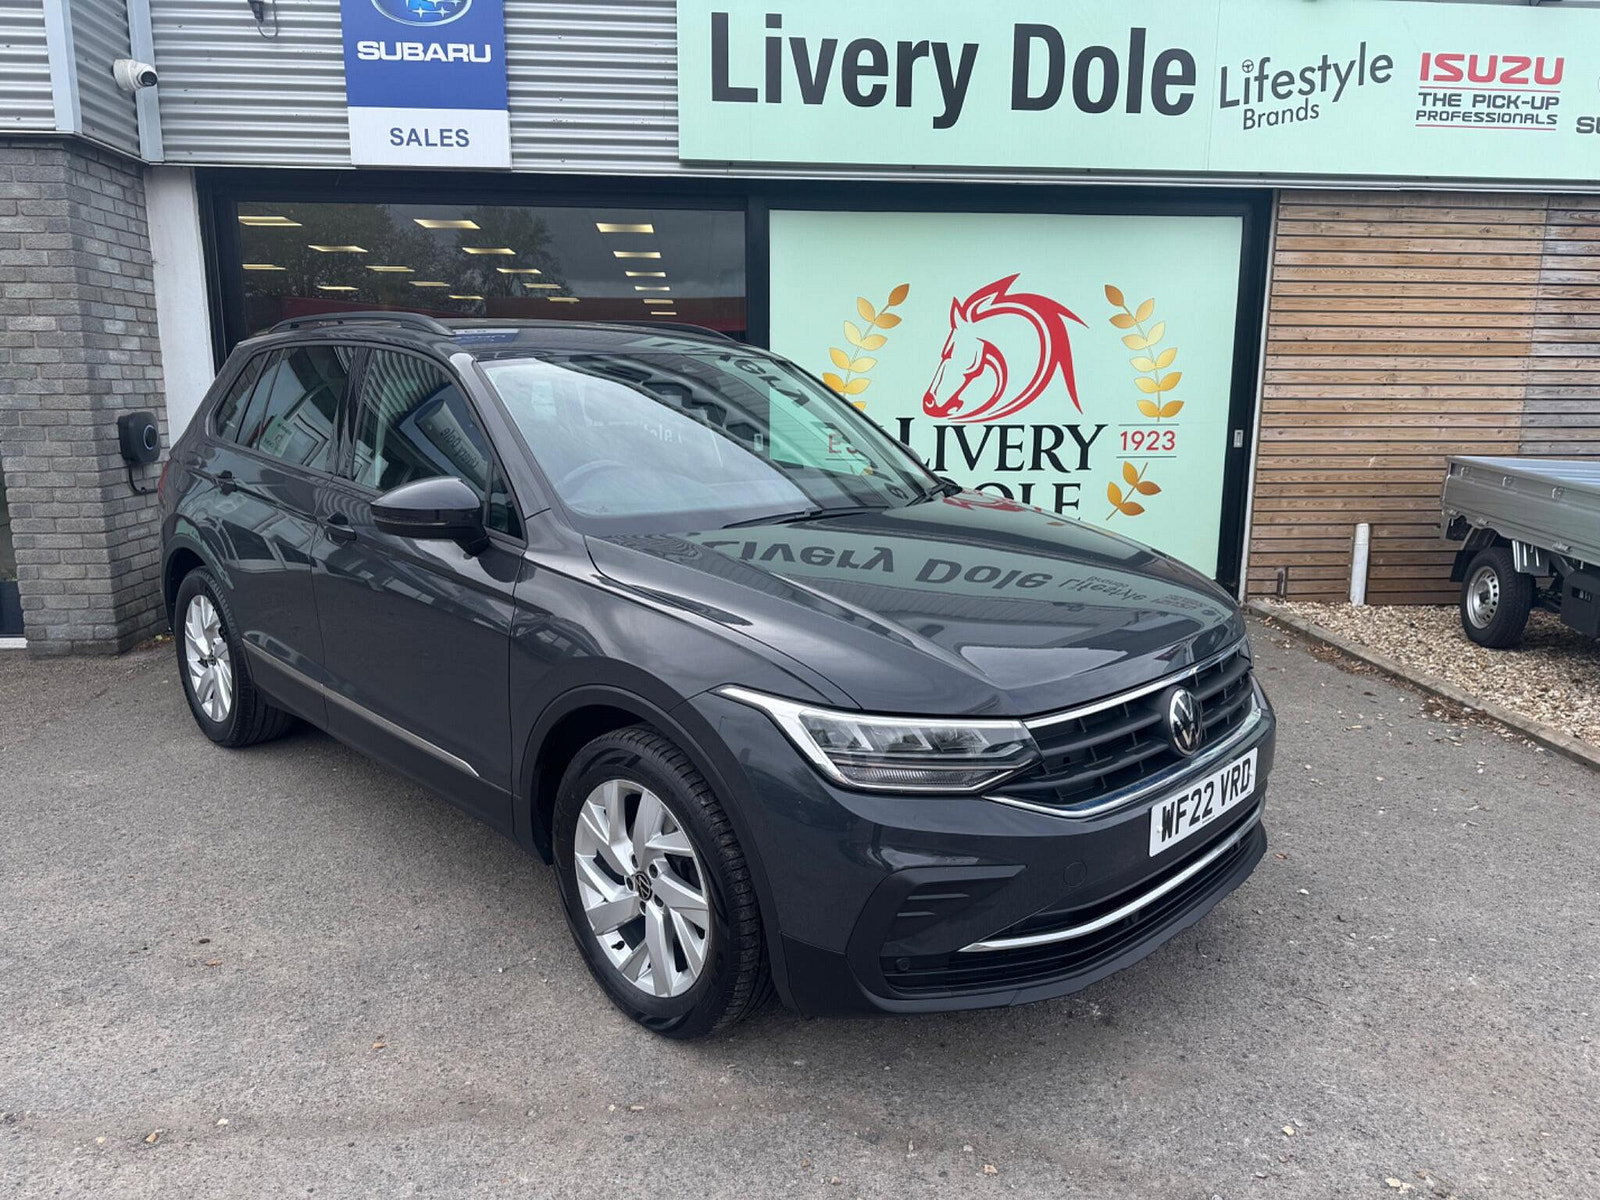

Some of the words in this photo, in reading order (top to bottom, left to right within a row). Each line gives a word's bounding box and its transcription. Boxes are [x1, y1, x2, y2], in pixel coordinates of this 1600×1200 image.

[357, 40, 492, 63] SUBARU
[711, 12, 979, 129] Livery
[1011, 23, 1196, 116] Dole
[1220, 41, 1394, 109] Lifestyle
[1419, 52, 1565, 86] ISUZU
[1418, 92, 1462, 107] THE
[1472, 93, 1560, 111] PICK-UP
[1243, 97, 1320, 130] Brands
[1415, 109, 1558, 126] PROFESSIONALS
[1576, 116, 1600, 135] S
[390, 127, 470, 148] SALES
[1120, 429, 1176, 451] 1923
[1161, 780, 1214, 843] WF22
[1220, 756, 1251, 807] VRD
